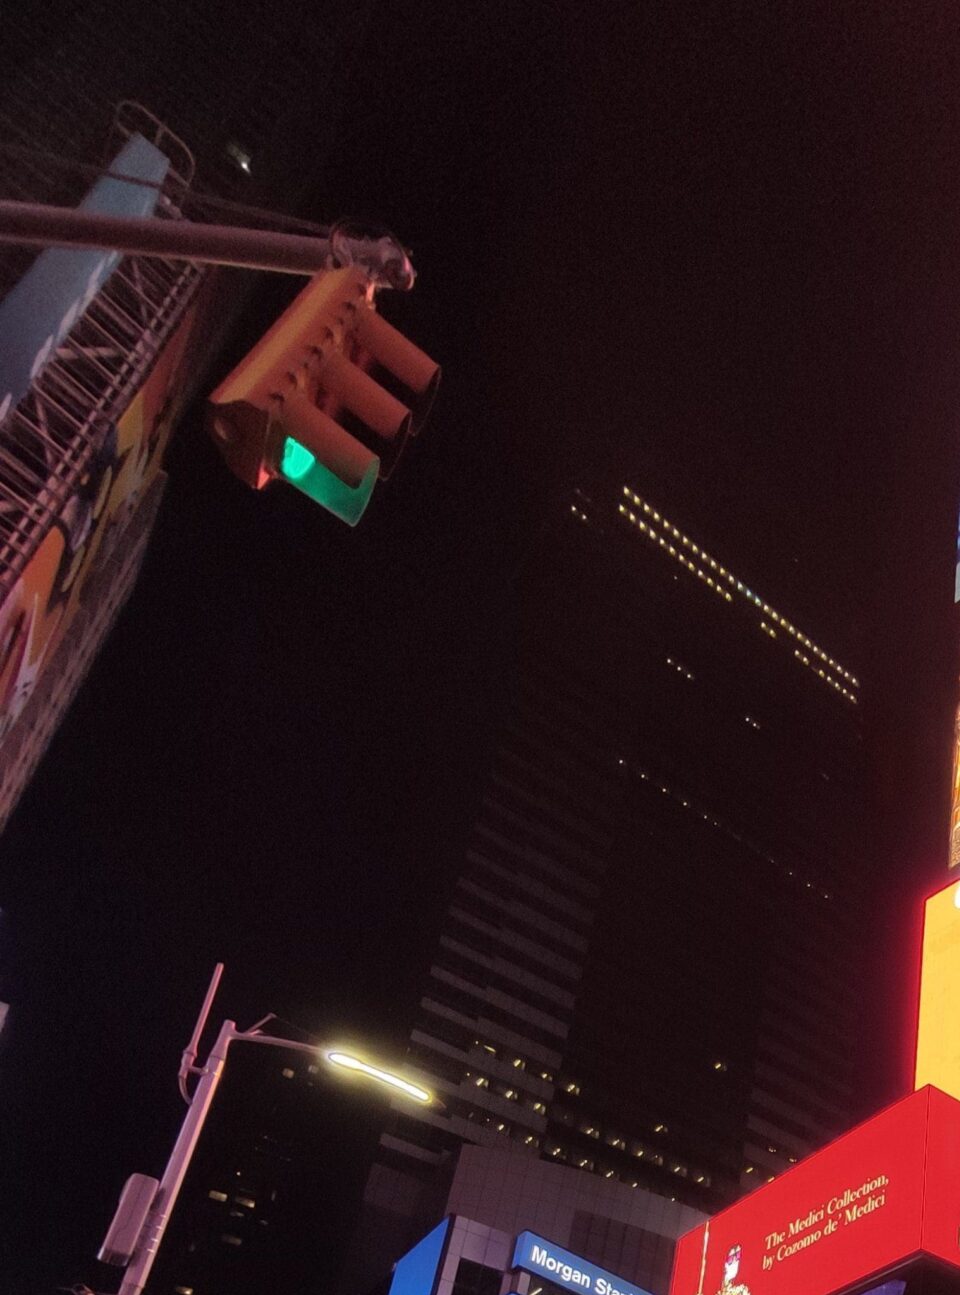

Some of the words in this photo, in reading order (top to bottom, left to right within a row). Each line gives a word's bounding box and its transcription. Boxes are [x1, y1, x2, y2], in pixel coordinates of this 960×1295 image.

[762, 1255, 775, 1271] by
[777, 1230, 822, 1261] Cozomo
[844, 1190, 885, 1225] Medici
[765, 1232, 785, 1250] The
[788, 1204, 825, 1237] Medici
[827, 1175, 889, 1215] Collection,
[531, 1245, 591, 1289] Morgan
